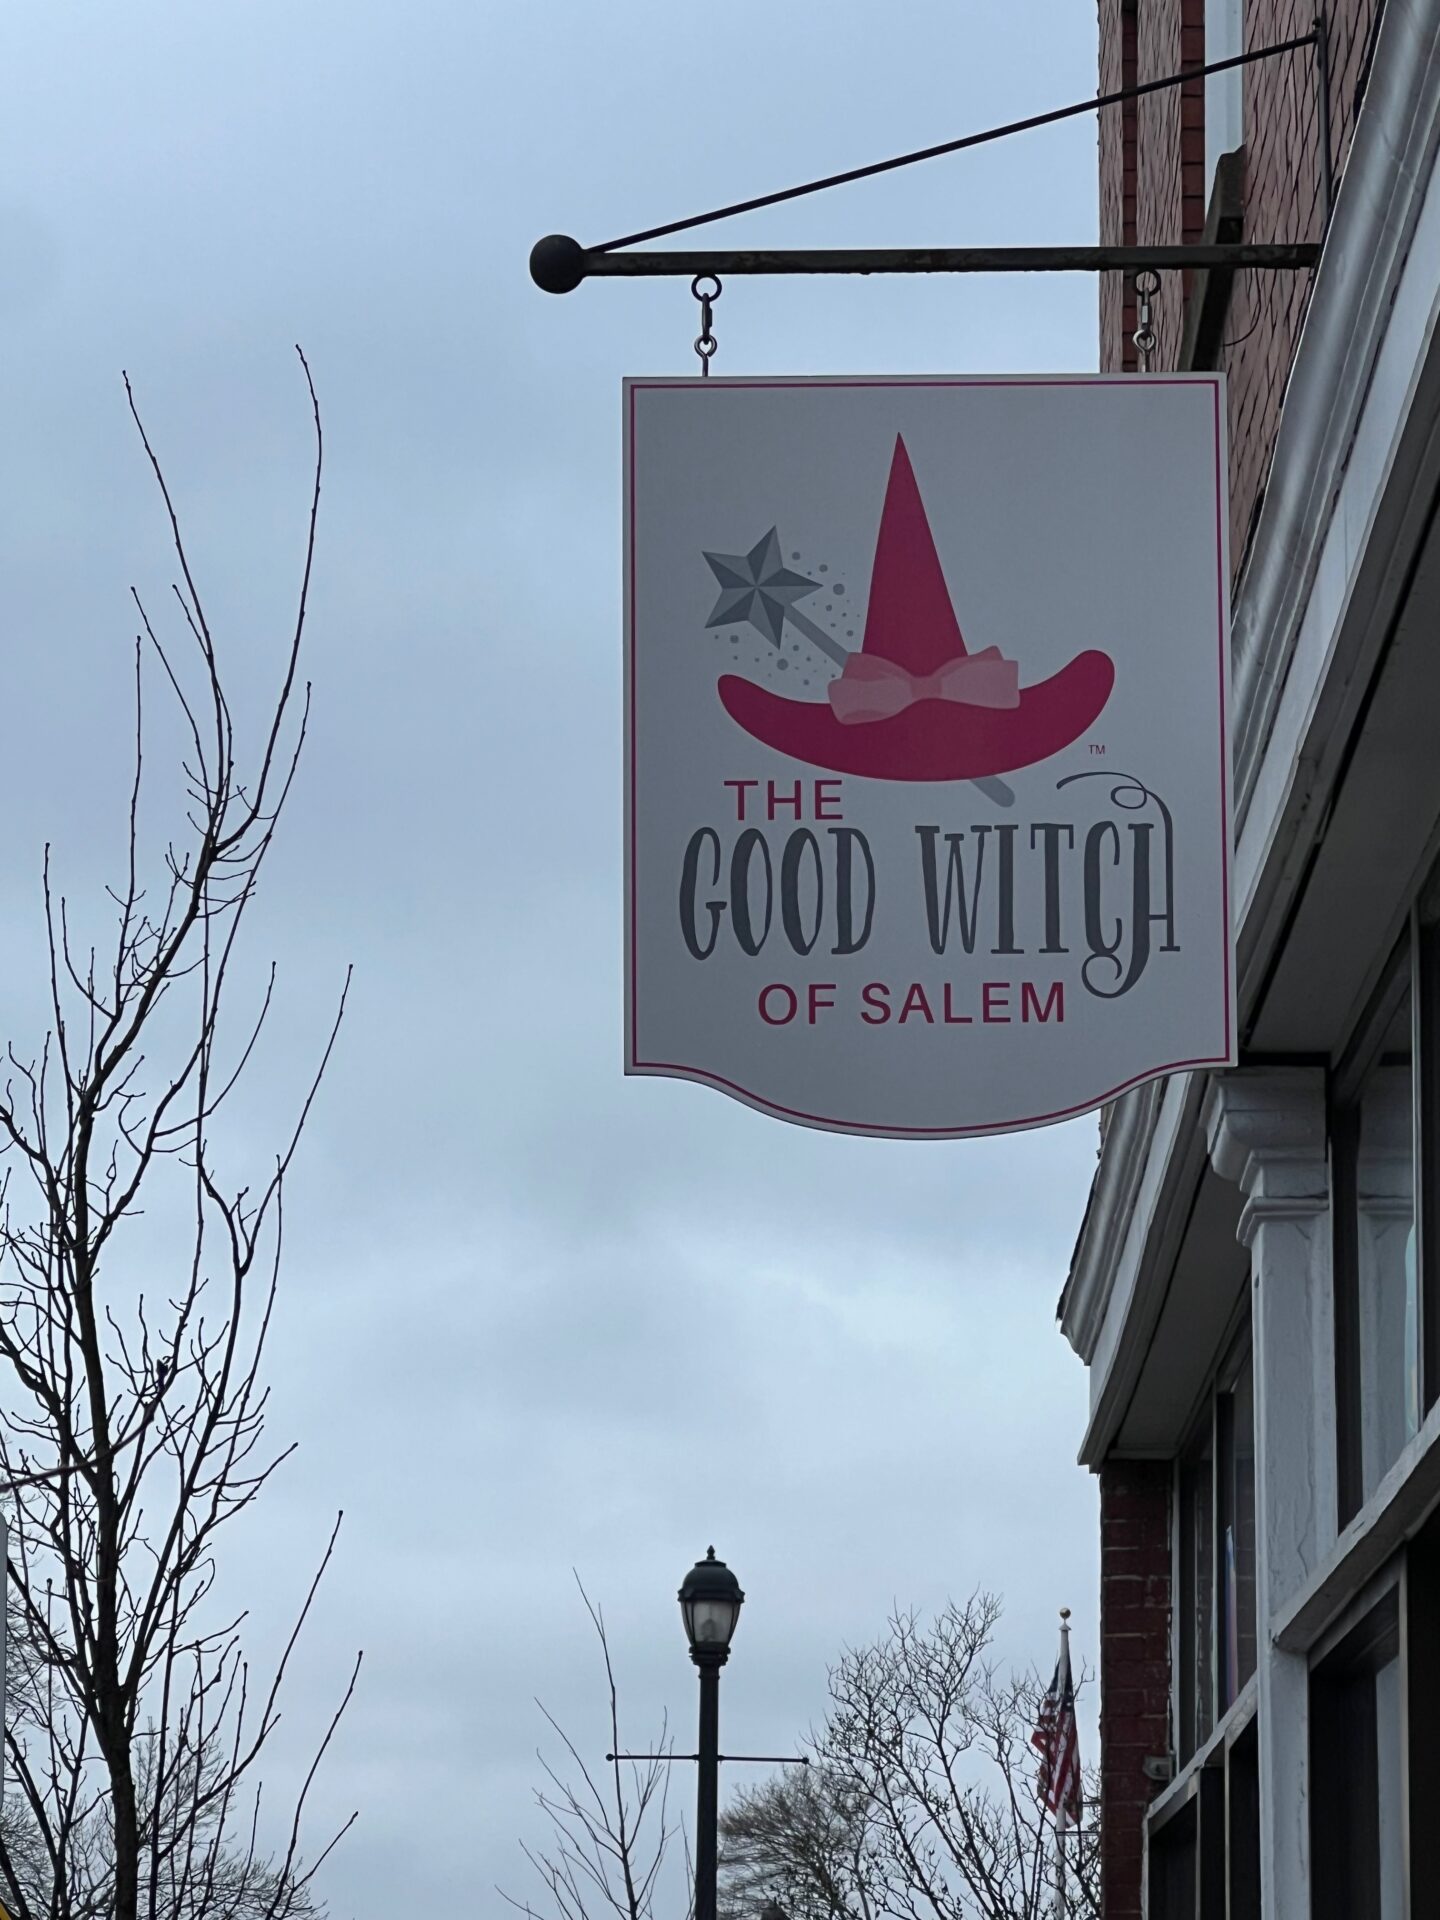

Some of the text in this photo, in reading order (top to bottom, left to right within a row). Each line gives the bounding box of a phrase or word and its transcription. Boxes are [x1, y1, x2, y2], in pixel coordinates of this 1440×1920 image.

[723, 779, 843, 821] THE
[678, 771, 1181, 998] GOOD WITCH
[757, 981, 1066, 1026] OF SALEM
